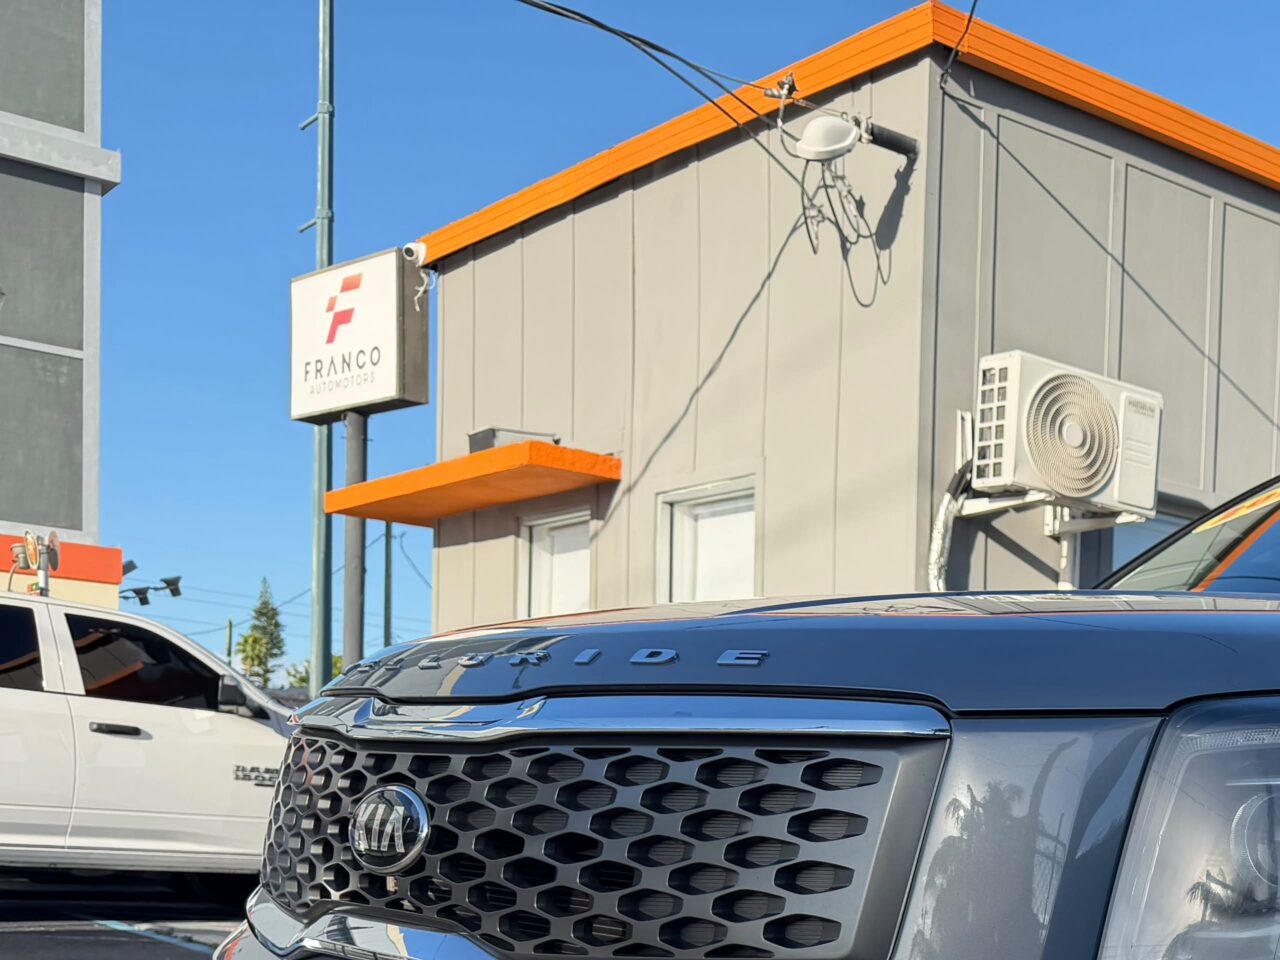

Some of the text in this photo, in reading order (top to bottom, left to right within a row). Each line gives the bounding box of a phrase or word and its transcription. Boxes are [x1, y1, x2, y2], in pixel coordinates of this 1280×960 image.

[303, 345, 382, 383] FRANCO
[309, 371, 376, 396] AUTOMOTORS
[353, 802, 406, 854] KIA
